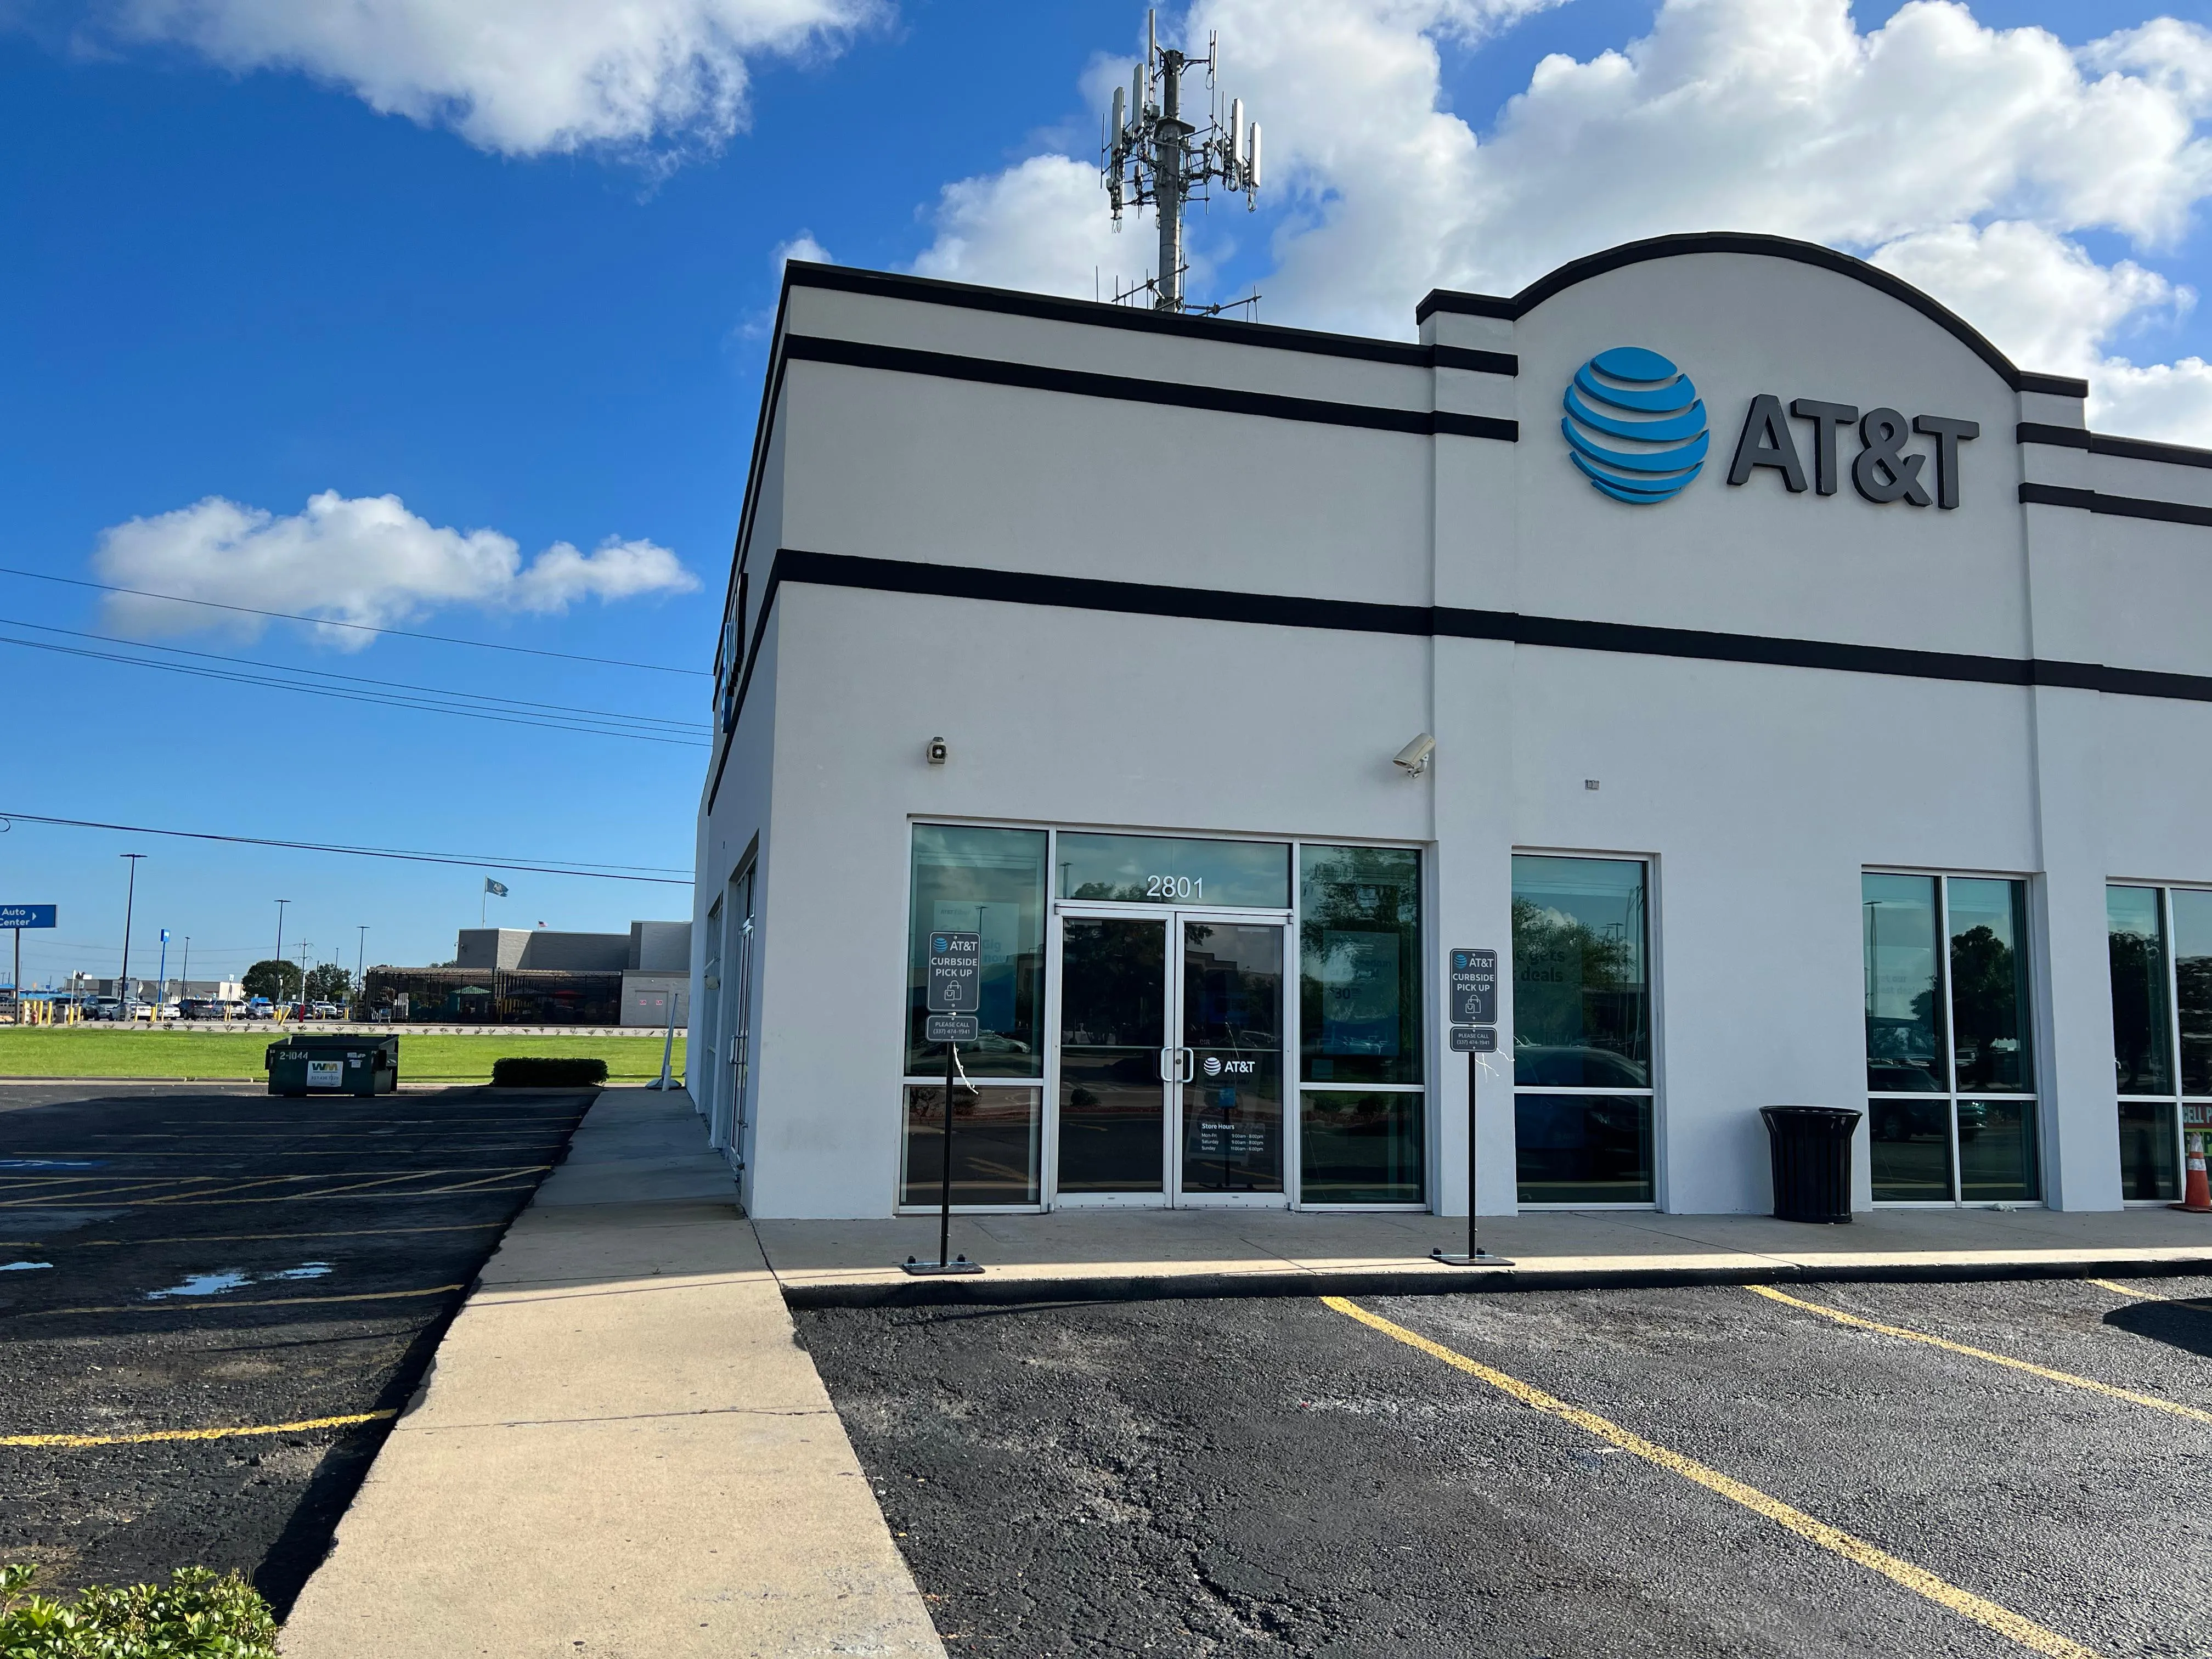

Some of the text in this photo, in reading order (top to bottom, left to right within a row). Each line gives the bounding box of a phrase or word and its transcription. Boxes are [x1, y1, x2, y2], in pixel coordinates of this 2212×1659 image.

[1726, 394, 1980, 510] AT&T
[1146, 874, 1203, 899] 2801
[2, 907, 26, 916] Auto
[0, 918, 30, 926] Center
[950, 941, 978, 951] AT&T
[931, 957, 978, 966] CURBSIDE
[1469, 958, 1494, 968] AT&T
[960, 969, 973, 977] UP
[1453, 973, 1494, 981] CURBSIDE
[1521, 966, 1564, 982] deals
[1457, 983, 1477, 991] PICK
[280, 1051, 308, 1060] 2-1044
[312, 1063, 338, 1071] WM
[1224, 1060, 1255, 1073] AT&T
[2183, 1106, 2204, 1124] CELL
